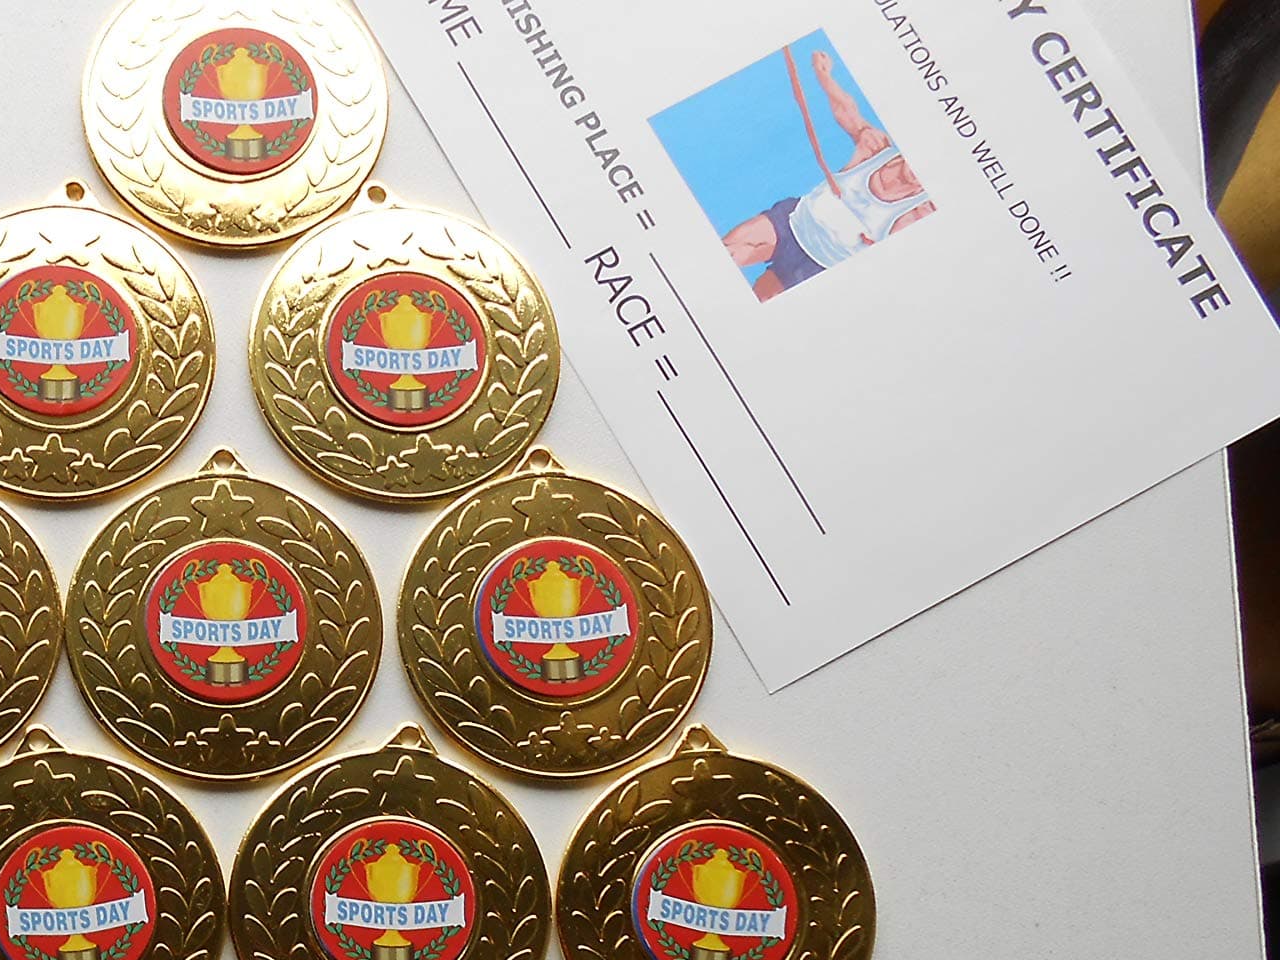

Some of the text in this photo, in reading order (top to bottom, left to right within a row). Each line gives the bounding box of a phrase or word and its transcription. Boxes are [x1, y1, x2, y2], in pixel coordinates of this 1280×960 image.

[192, 99, 298, 120] SPORTS DAY
[501, 0, 585, 109] ISHING
[575, 111, 645, 203] PLACE
[938, 96, 977, 138] AND
[971, 140, 1014, 200] WELL
[1008, 200, 1059, 263] DONE
[1050, 264, 1072, 282] !!
[1031, 32, 1231, 319] CERTIFICATE
[584, 246, 666, 347] RACE
[6, 339, 115, 361] SPORTS DAY
[355, 348, 462, 369] SPORTS DAY
[173, 619, 283, 643] SPORTS DAY
[505, 615, 614, 640] SPORTS DAY
[18, 901, 131, 933] SPORTS DAY
[336, 900, 451, 925] SPORTS DAY
[661, 899, 772, 933] SPORTS DAY
